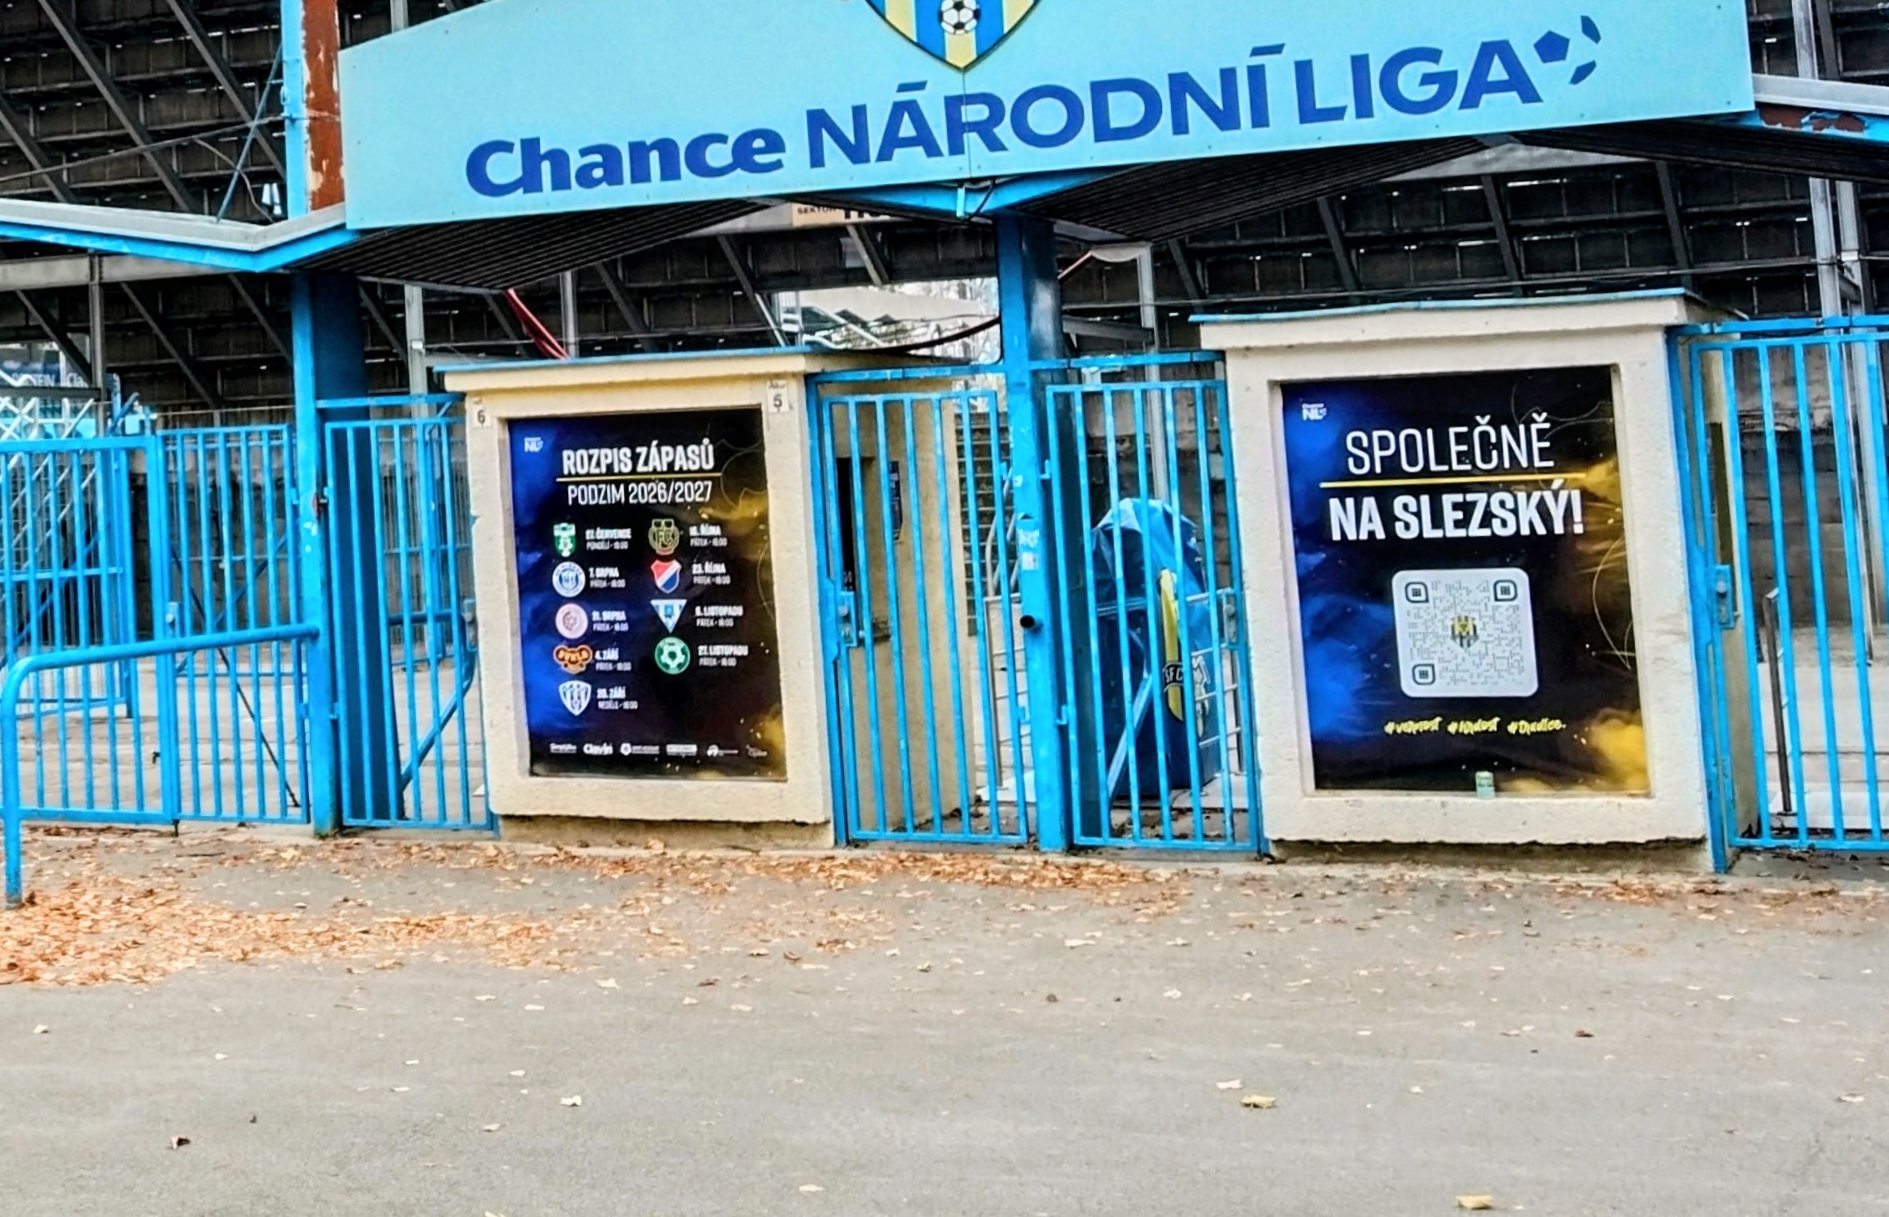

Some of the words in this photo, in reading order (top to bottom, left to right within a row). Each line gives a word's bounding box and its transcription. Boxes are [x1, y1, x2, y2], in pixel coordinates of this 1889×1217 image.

[464, 126, 787, 199] Chance
[1293, 38, 1544, 126] LIGA
[477, 409, 486, 424] 6
[773, 392, 783, 409] 5
[562, 446, 633, 476] ROZPIS
[635, 436, 715, 473] ZÁPASŮ
[1345, 412, 1555, 475] SPOLEČNĚ
[567, 483, 626, 506] PODZIM
[628, 480, 713, 505] 2026/2027
[1328, 496, 1386, 541] NA
[1393, 478, 1585, 540] SLEZSKÝ!
